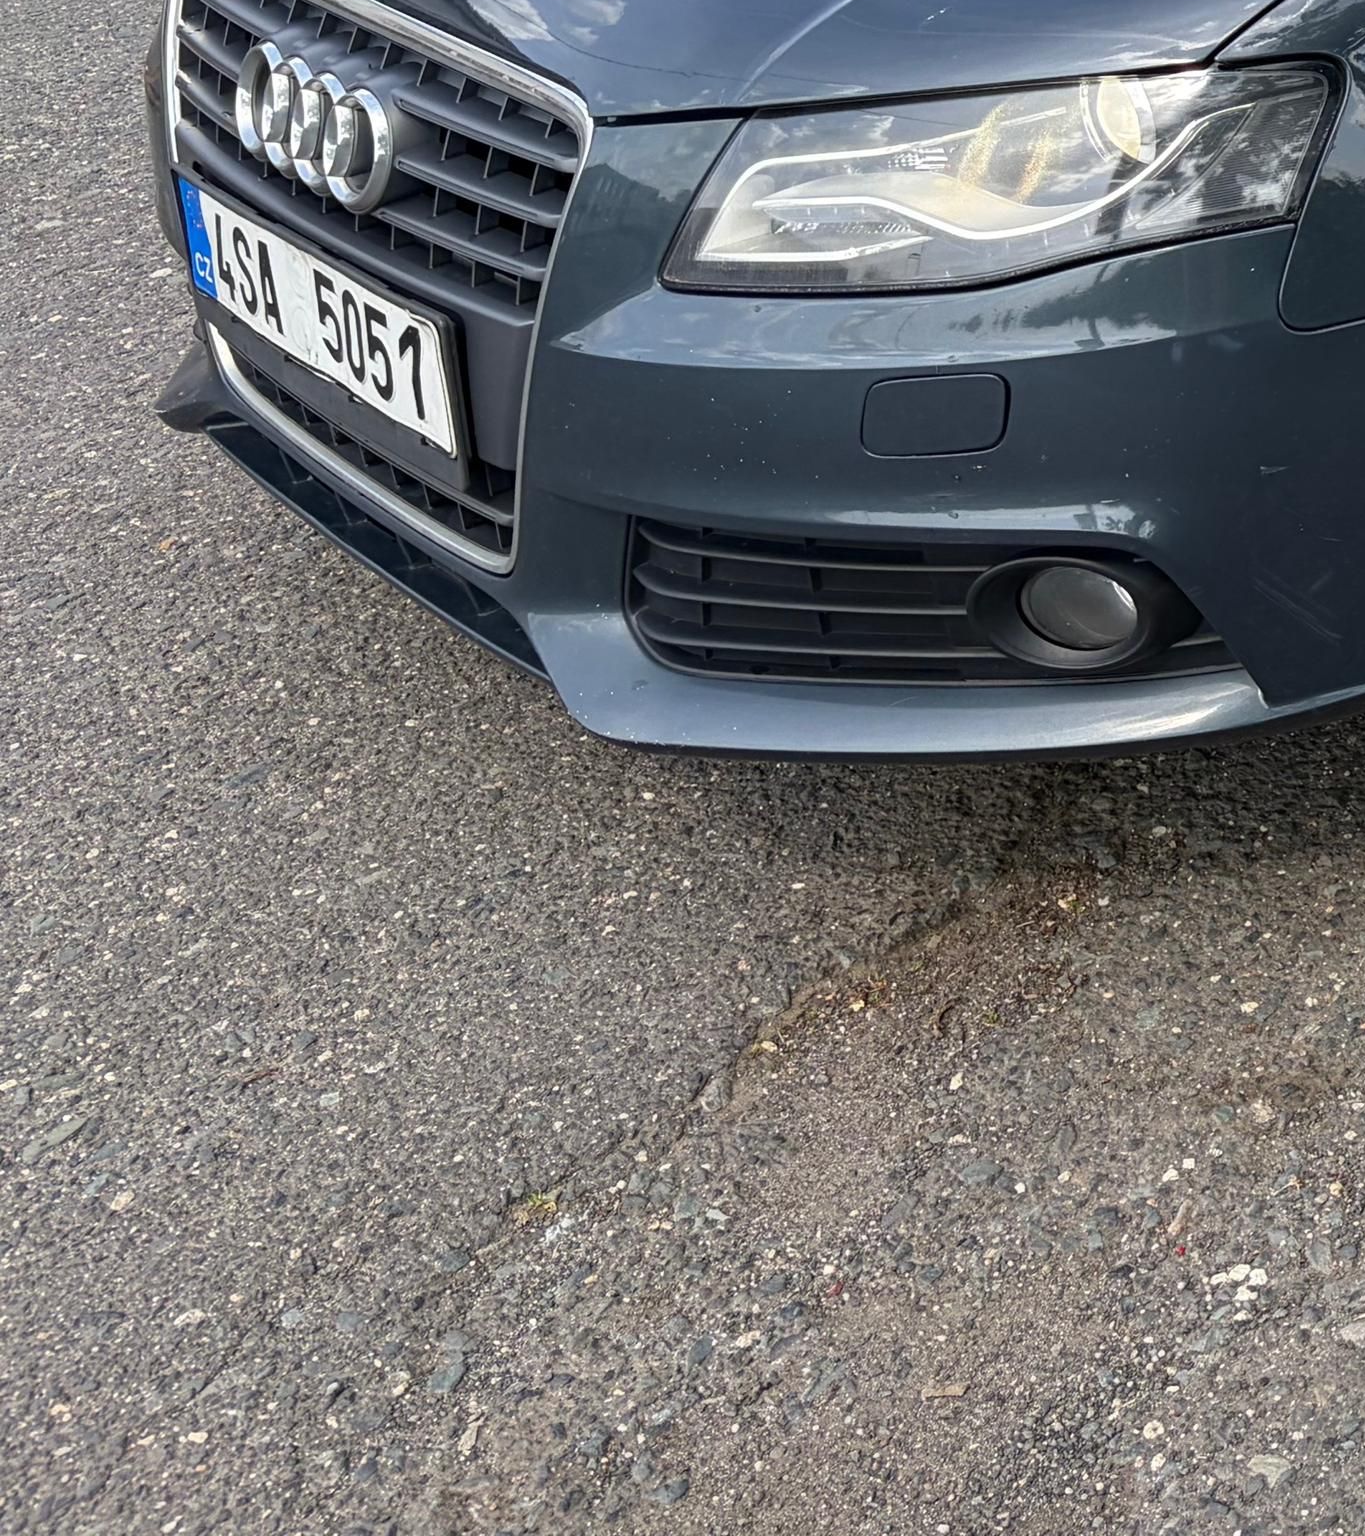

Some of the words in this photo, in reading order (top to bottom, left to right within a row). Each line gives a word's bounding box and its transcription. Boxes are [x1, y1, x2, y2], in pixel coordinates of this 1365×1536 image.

[194, 251, 214, 283] CZ
[214, 212, 286, 336] 4SA
[312, 268, 427, 421] 5051
